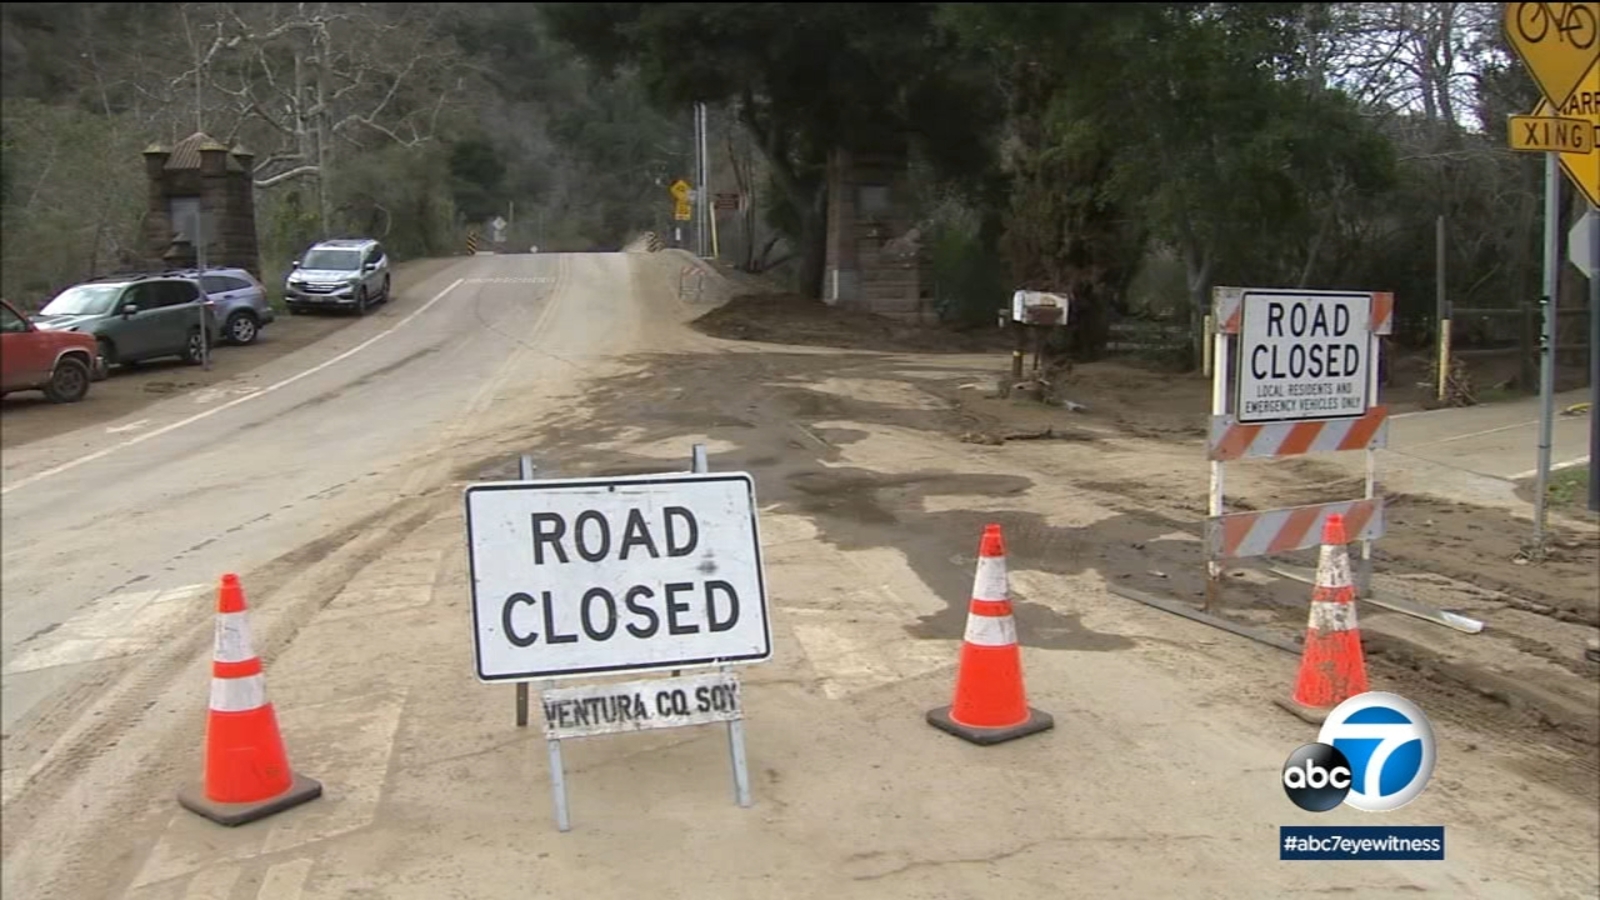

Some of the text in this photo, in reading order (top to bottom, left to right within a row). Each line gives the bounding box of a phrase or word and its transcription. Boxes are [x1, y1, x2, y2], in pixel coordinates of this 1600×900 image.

[1524, 121, 1583, 149] XING
[1267, 302, 1350, 338] ROAD
[1251, 343, 1360, 380] CLOSED
[1245, 396, 1360, 414] EMERGENCY VEHICLES ONLY
[1256, 381, 1353, 398] LOCAL RESIDENTS AND
[531, 506, 699, 565] ROAD
[501, 579, 740, 648] CLOSED
